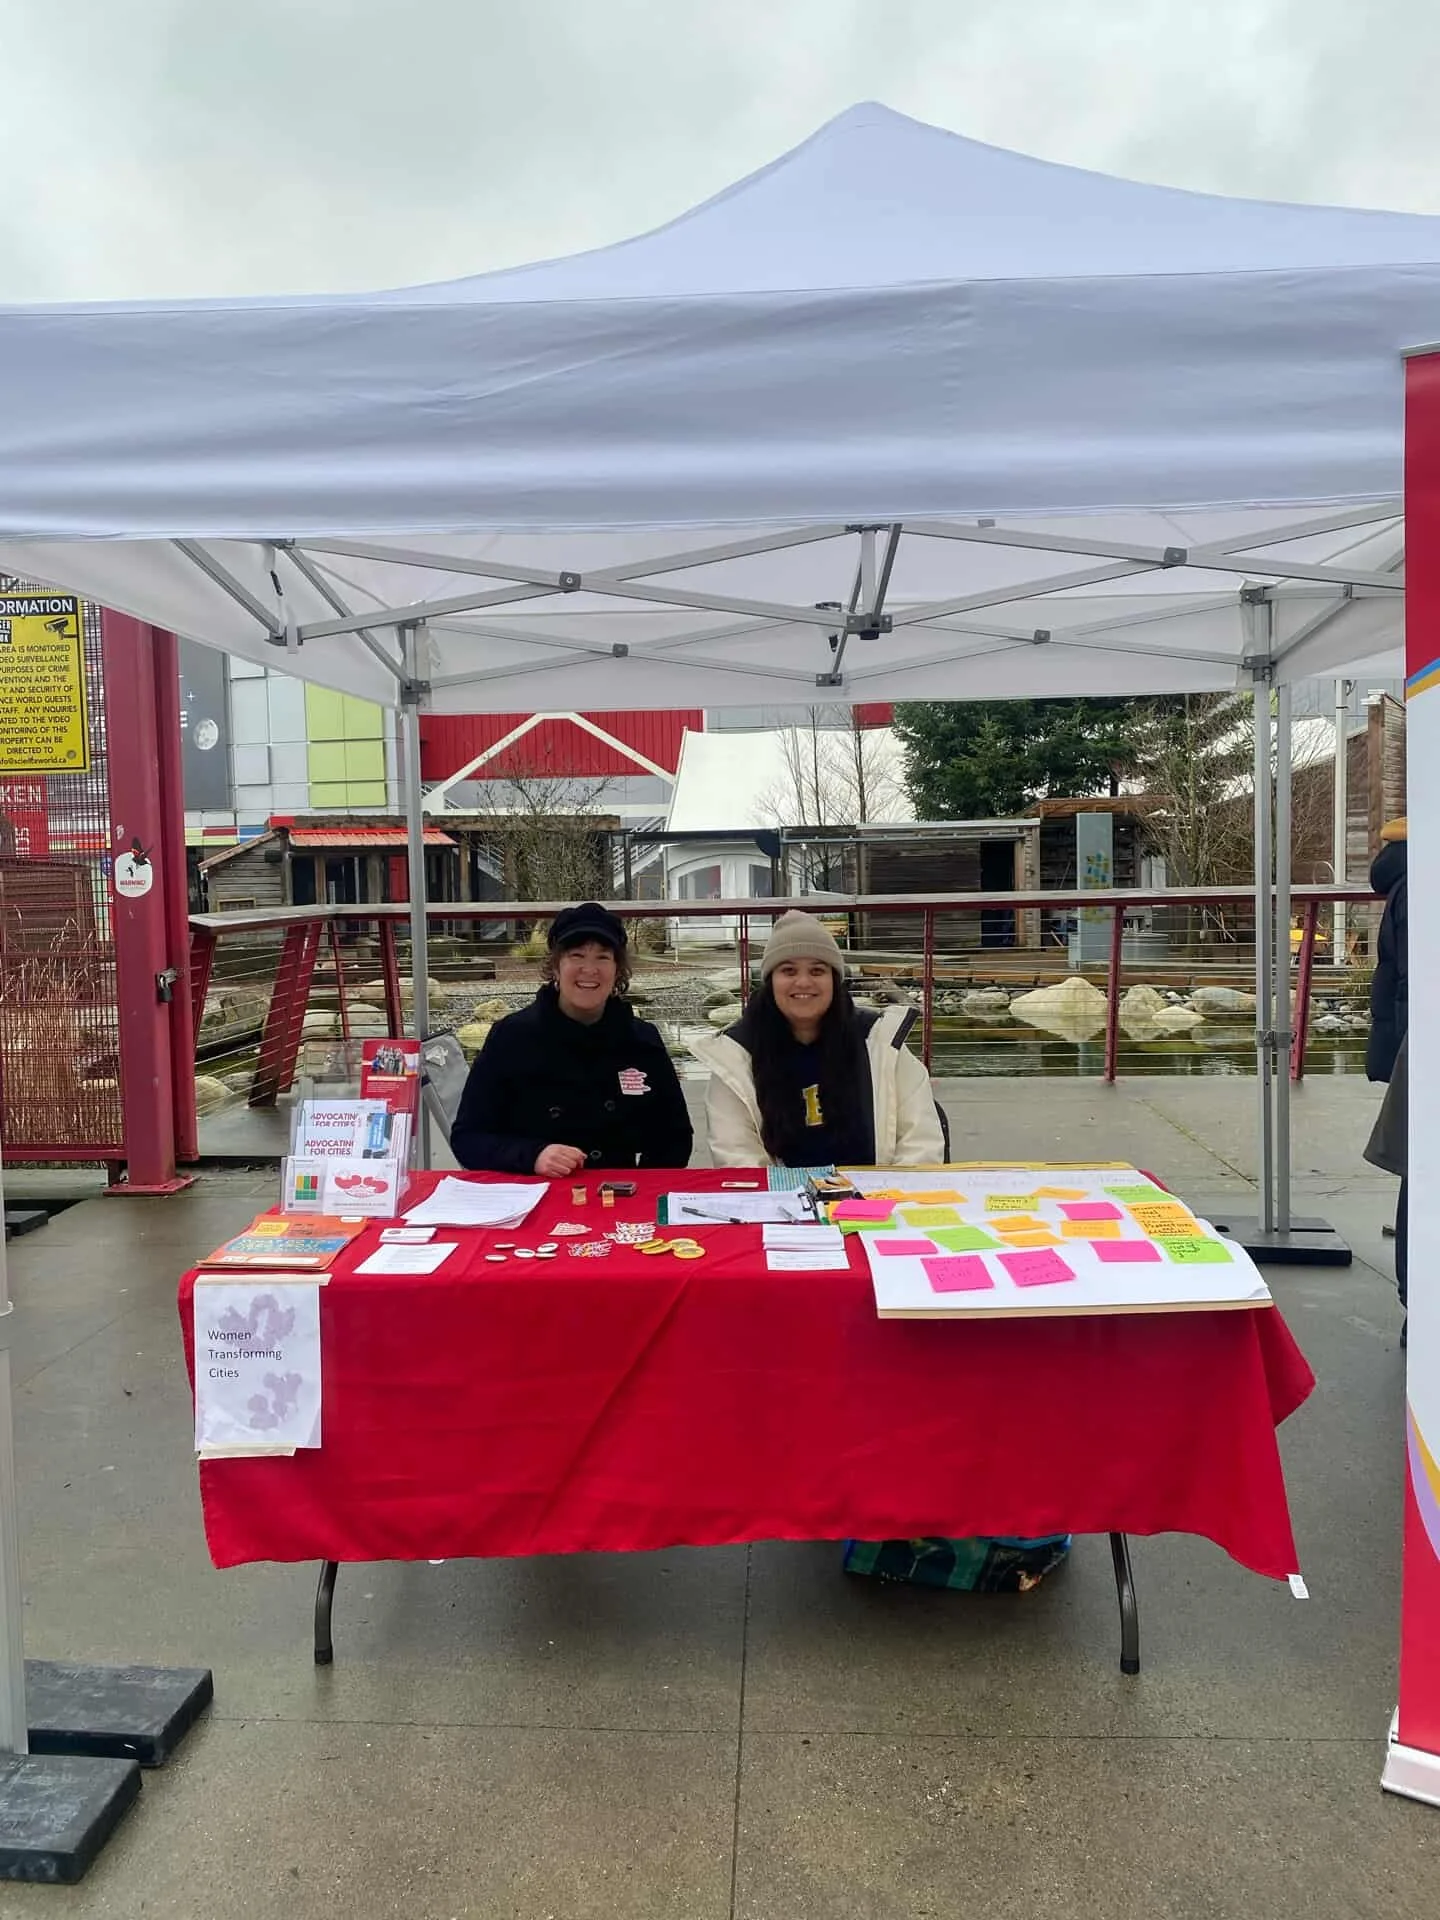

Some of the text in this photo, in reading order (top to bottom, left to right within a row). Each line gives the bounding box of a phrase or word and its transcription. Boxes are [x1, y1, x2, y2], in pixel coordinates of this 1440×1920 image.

[17, 655, 70, 663] SURVEILLANCE
[16, 696, 43, 704] WORLD
[42, 705, 77, 713] INQUIRIES
[48, 715, 71, 723] VIDEO
[310, 1148, 325, 1156] FOR
[208, 1329, 251, 1341] Women
[208, 1348, 282, 1361] Transforming
[209, 1367, 239, 1378] Cities
